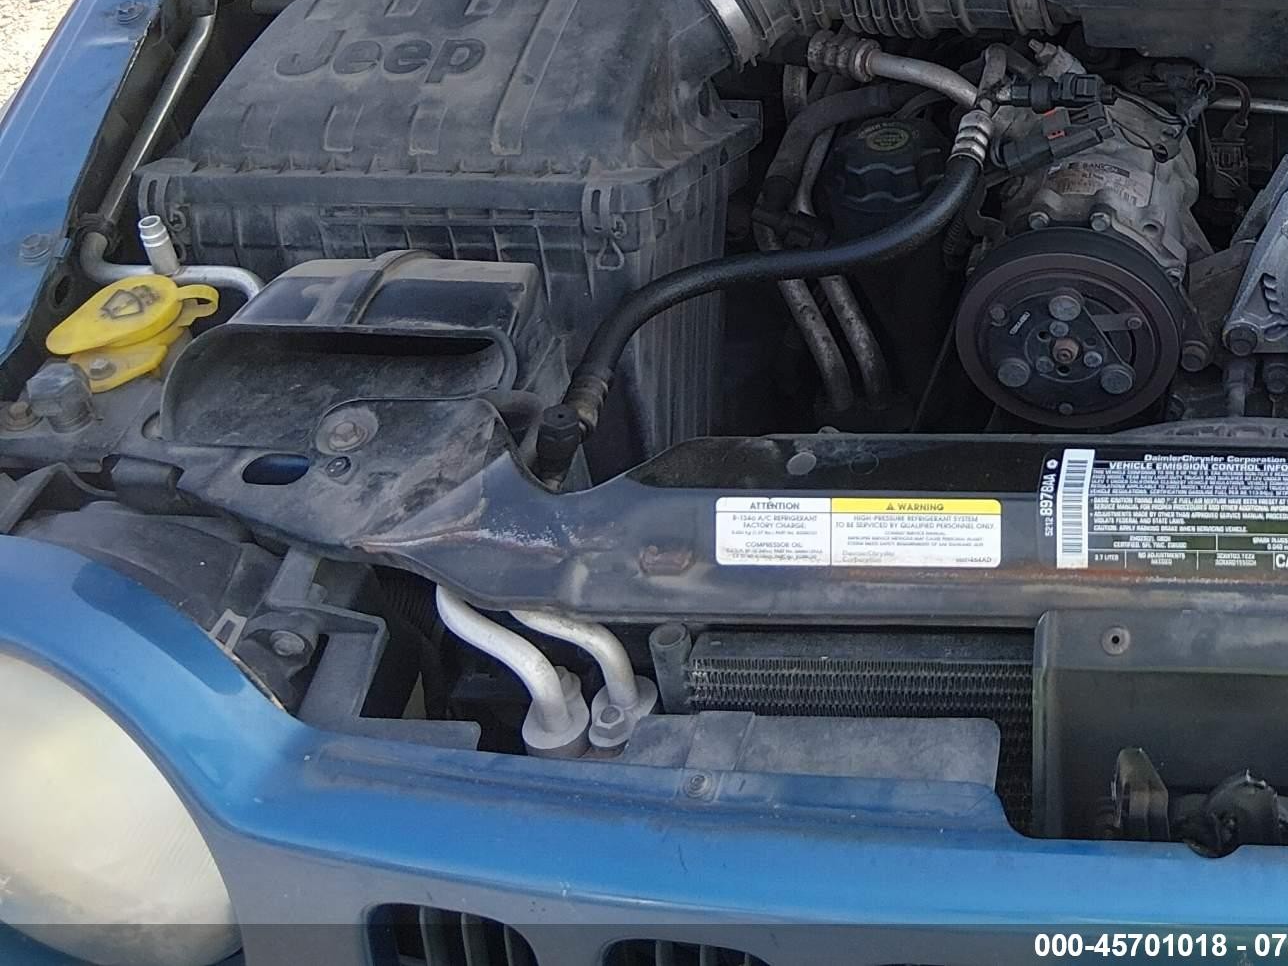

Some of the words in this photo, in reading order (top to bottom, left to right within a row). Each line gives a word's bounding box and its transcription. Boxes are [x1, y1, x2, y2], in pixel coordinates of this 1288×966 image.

[274, 29, 486, 83] Jeep
[1144, 454, 1224, 465] DaimlerChrysler
[1226, 455, 1287, 465] Corporation
[1109, 462, 1153, 470] VEHICLE
[1155, 462, 1209, 471] EMISSION
[1211, 463, 1262, 472] CONTROL
[749, 502, 800, 510] ATTENTION
[897, 502, 945, 511] WARNING
